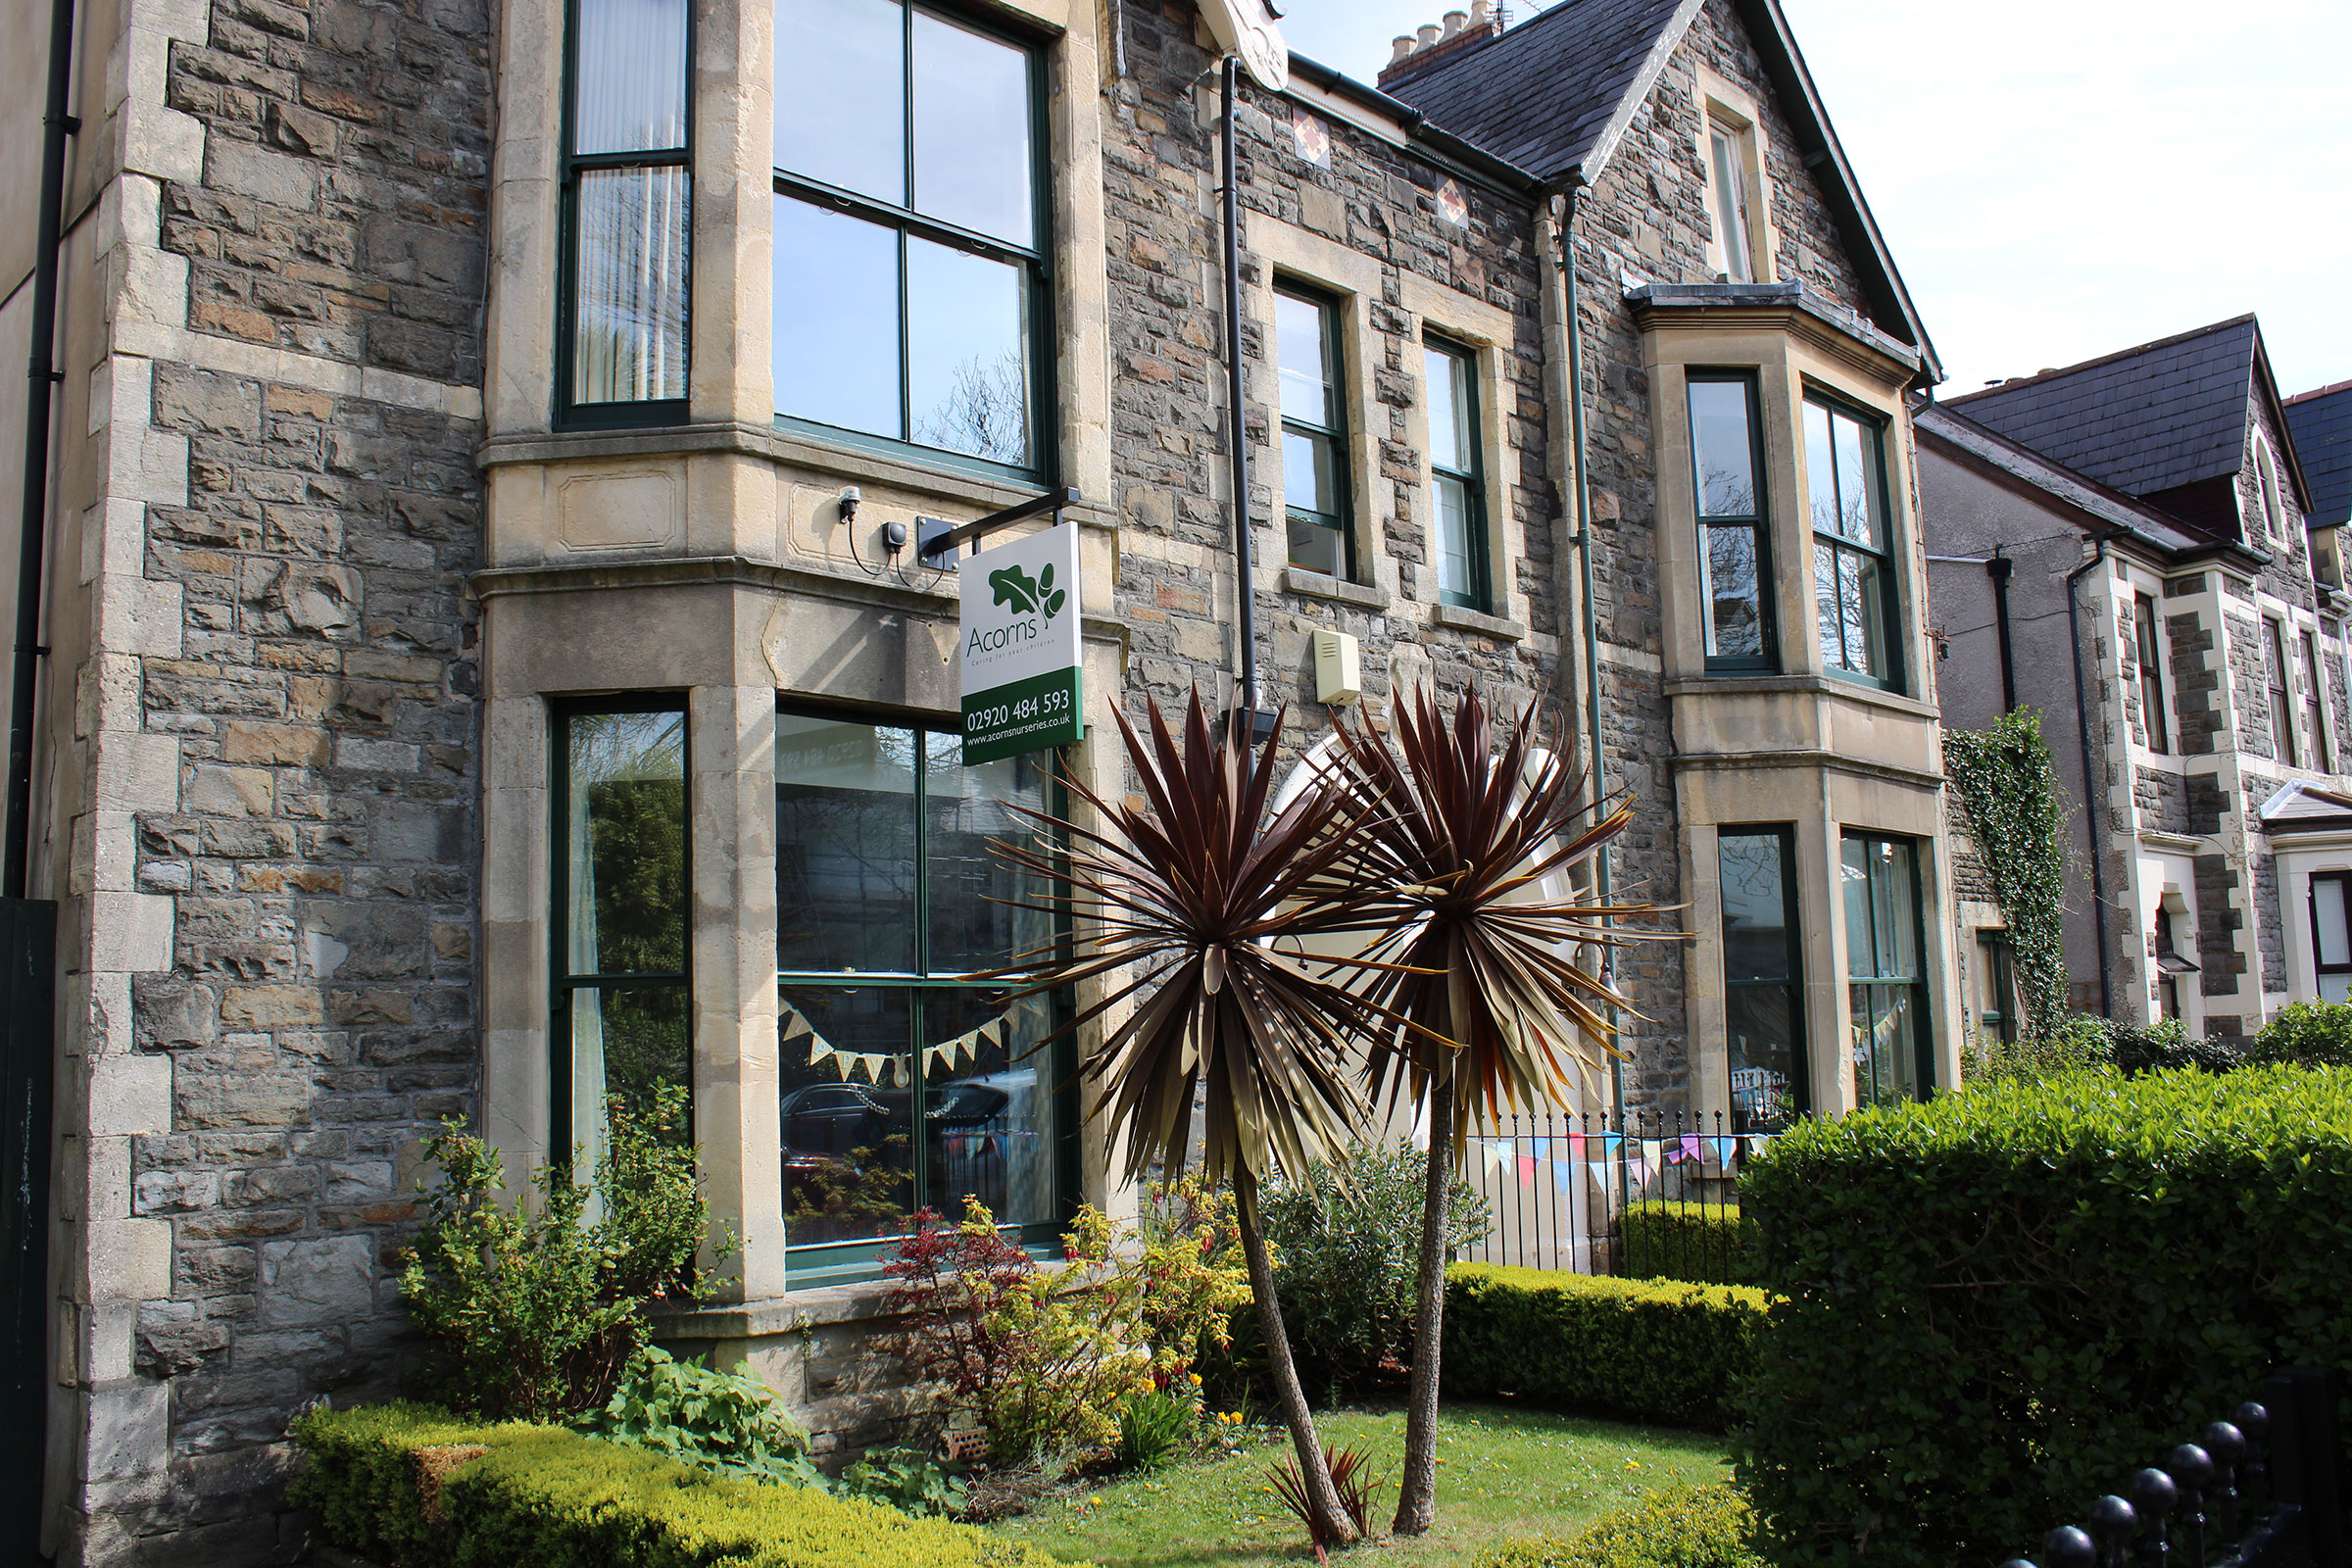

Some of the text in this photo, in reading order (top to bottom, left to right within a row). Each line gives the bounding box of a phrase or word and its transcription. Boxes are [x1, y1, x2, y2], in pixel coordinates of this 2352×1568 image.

[967, 618, 1037, 658] Acorns
[971, 657, 993, 666] Caring
[1008, 648, 1023, 658] your
[1026, 638, 1055, 651] children
[967, 689, 1070, 732] 02920 484 593
[967, 713, 1071, 746] www.acornsnurseries.co.uk
